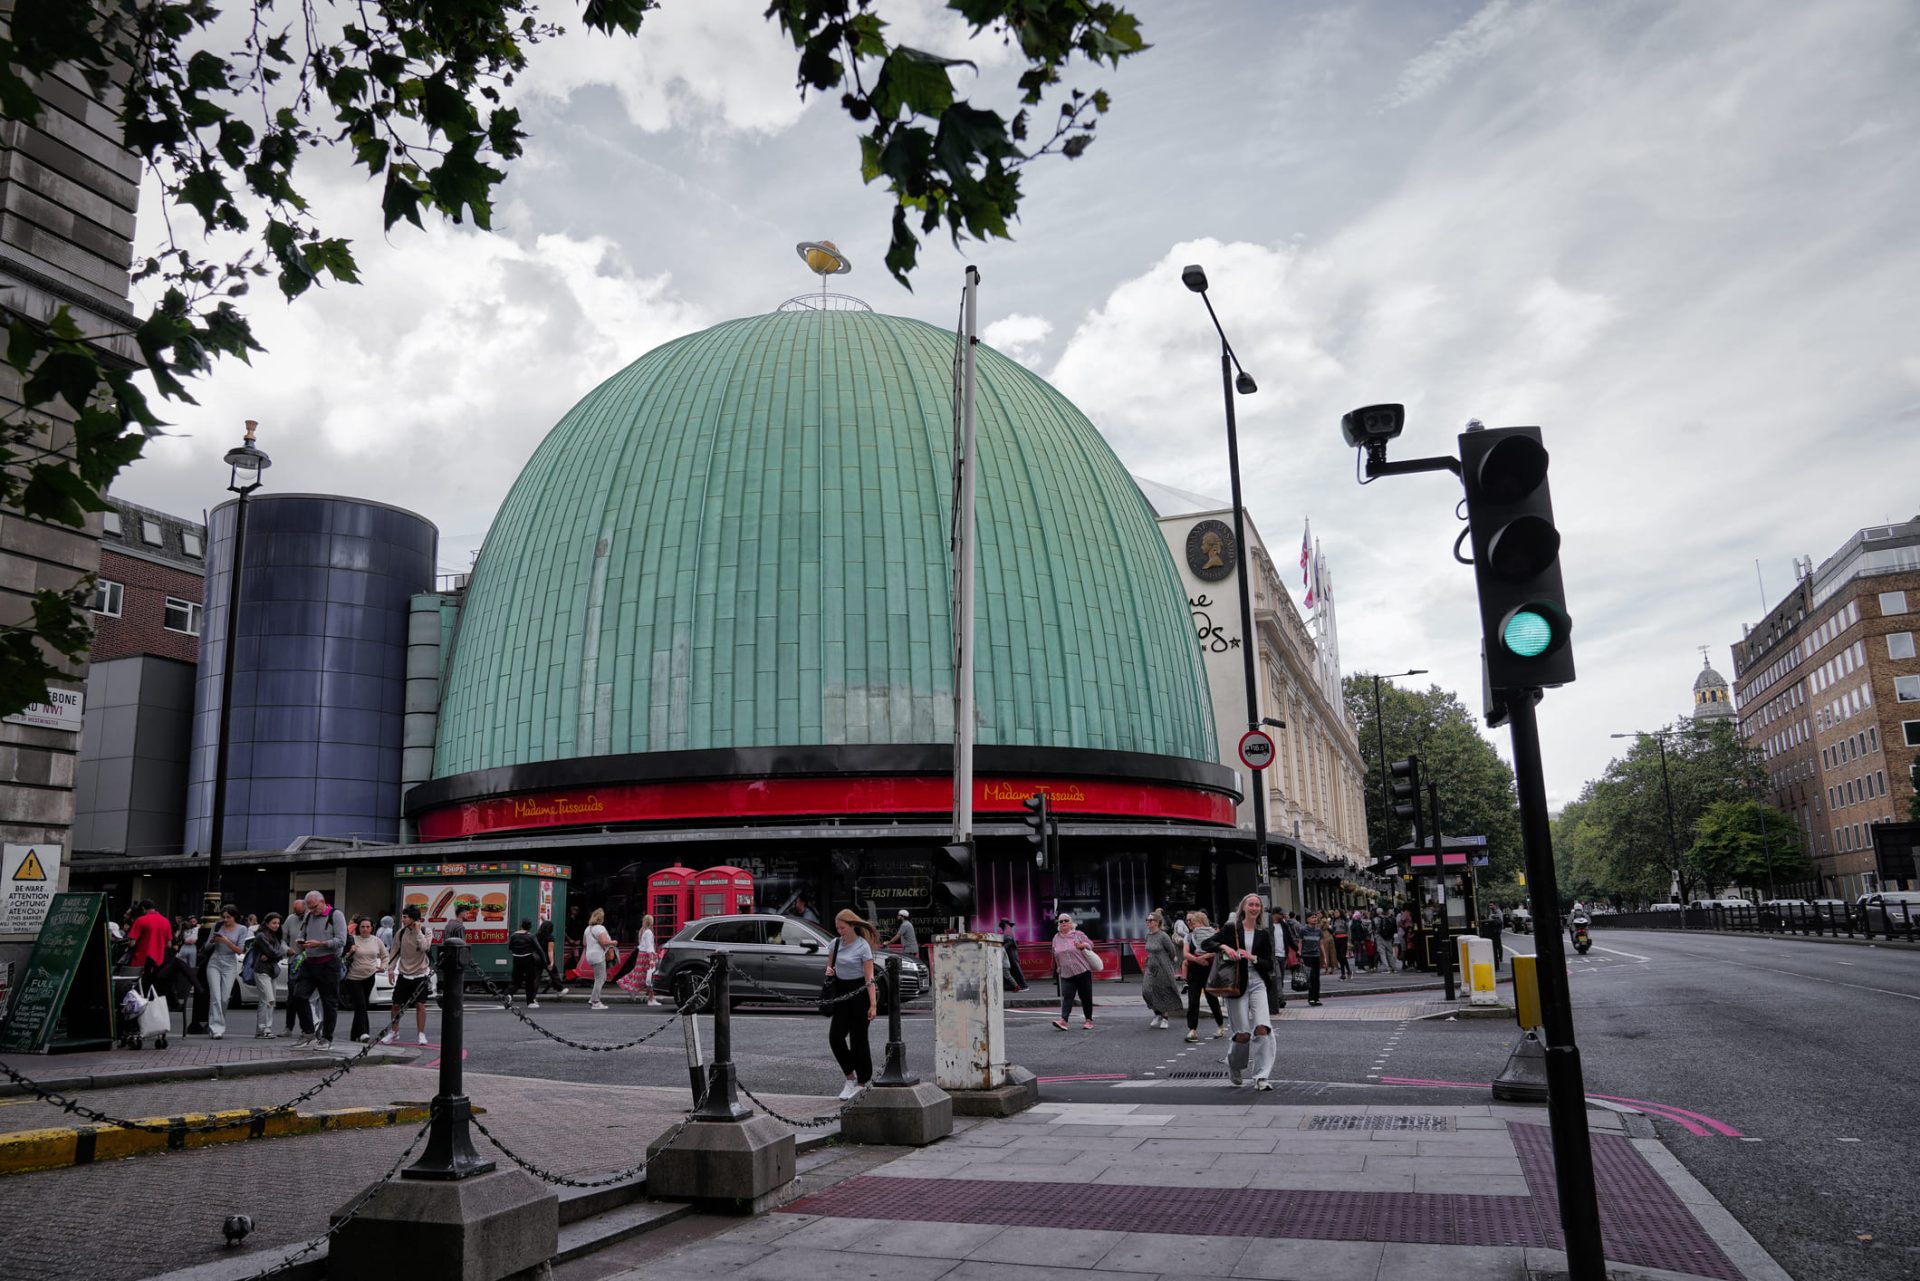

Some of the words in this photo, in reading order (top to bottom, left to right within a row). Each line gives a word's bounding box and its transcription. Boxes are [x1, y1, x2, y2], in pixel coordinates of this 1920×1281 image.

[48, 692, 77, 705] EBONE
[43, 704, 63, 715] NW1
[1034, 785, 1085, 801] Tssauds
[515, 798, 557, 818] Madame
[555, 795, 605, 814] Tussauds
[444, 866, 464, 874] CHIPS
[871, 888, 891, 898] FAST
[892, 888, 918, 897] TRACK
[474, 932, 479, 940] &
[481, 931, 504, 940] Drinks
[32, 979, 54, 988] FULL
